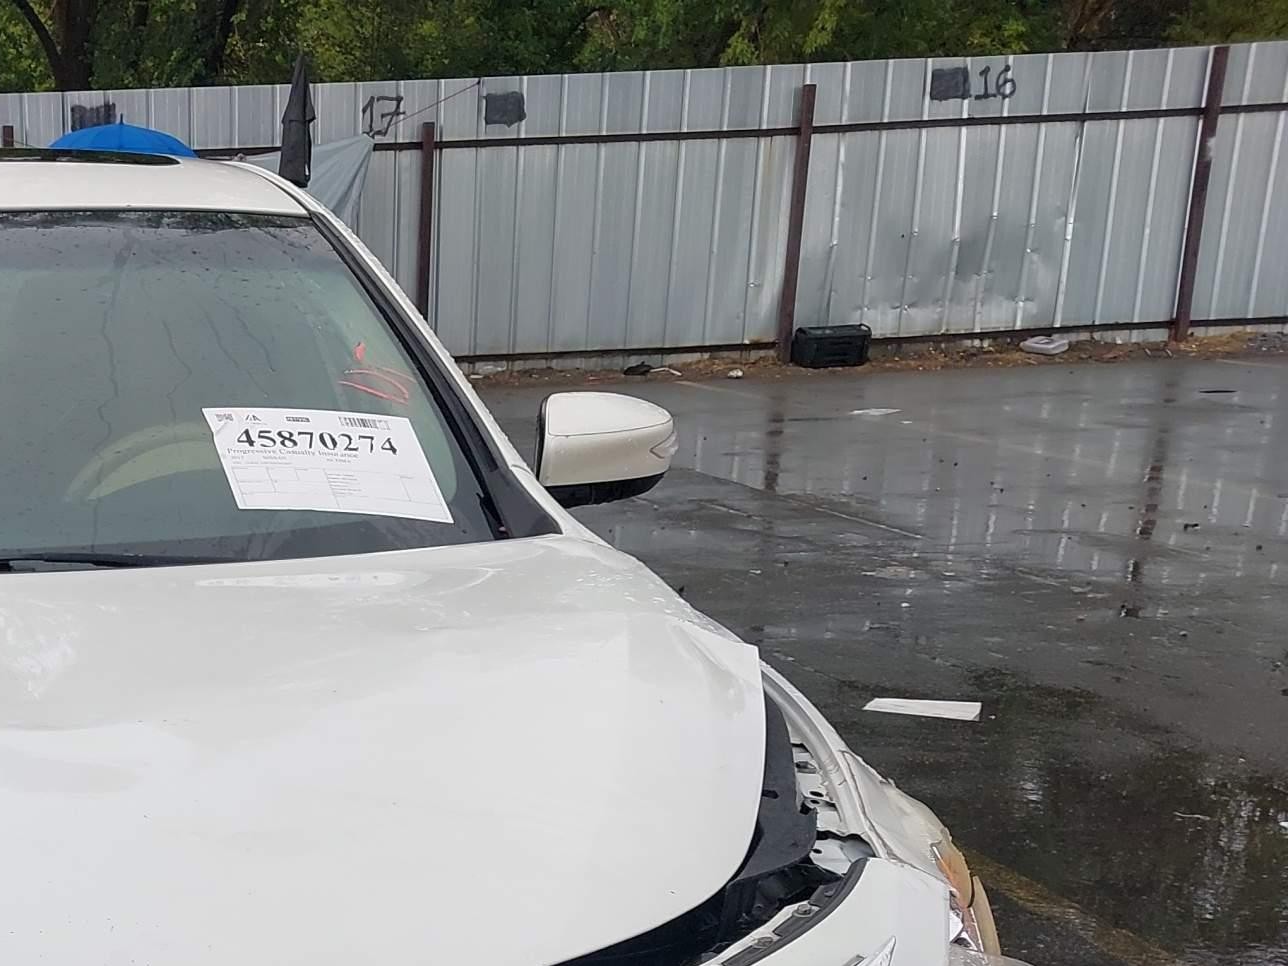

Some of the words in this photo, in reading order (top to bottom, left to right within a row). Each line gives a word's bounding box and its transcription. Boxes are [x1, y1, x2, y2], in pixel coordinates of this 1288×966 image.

[974, 64, 1017, 100] 16
[362, 95, 406, 140] 17
[236, 428, 398, 455] 45870274
